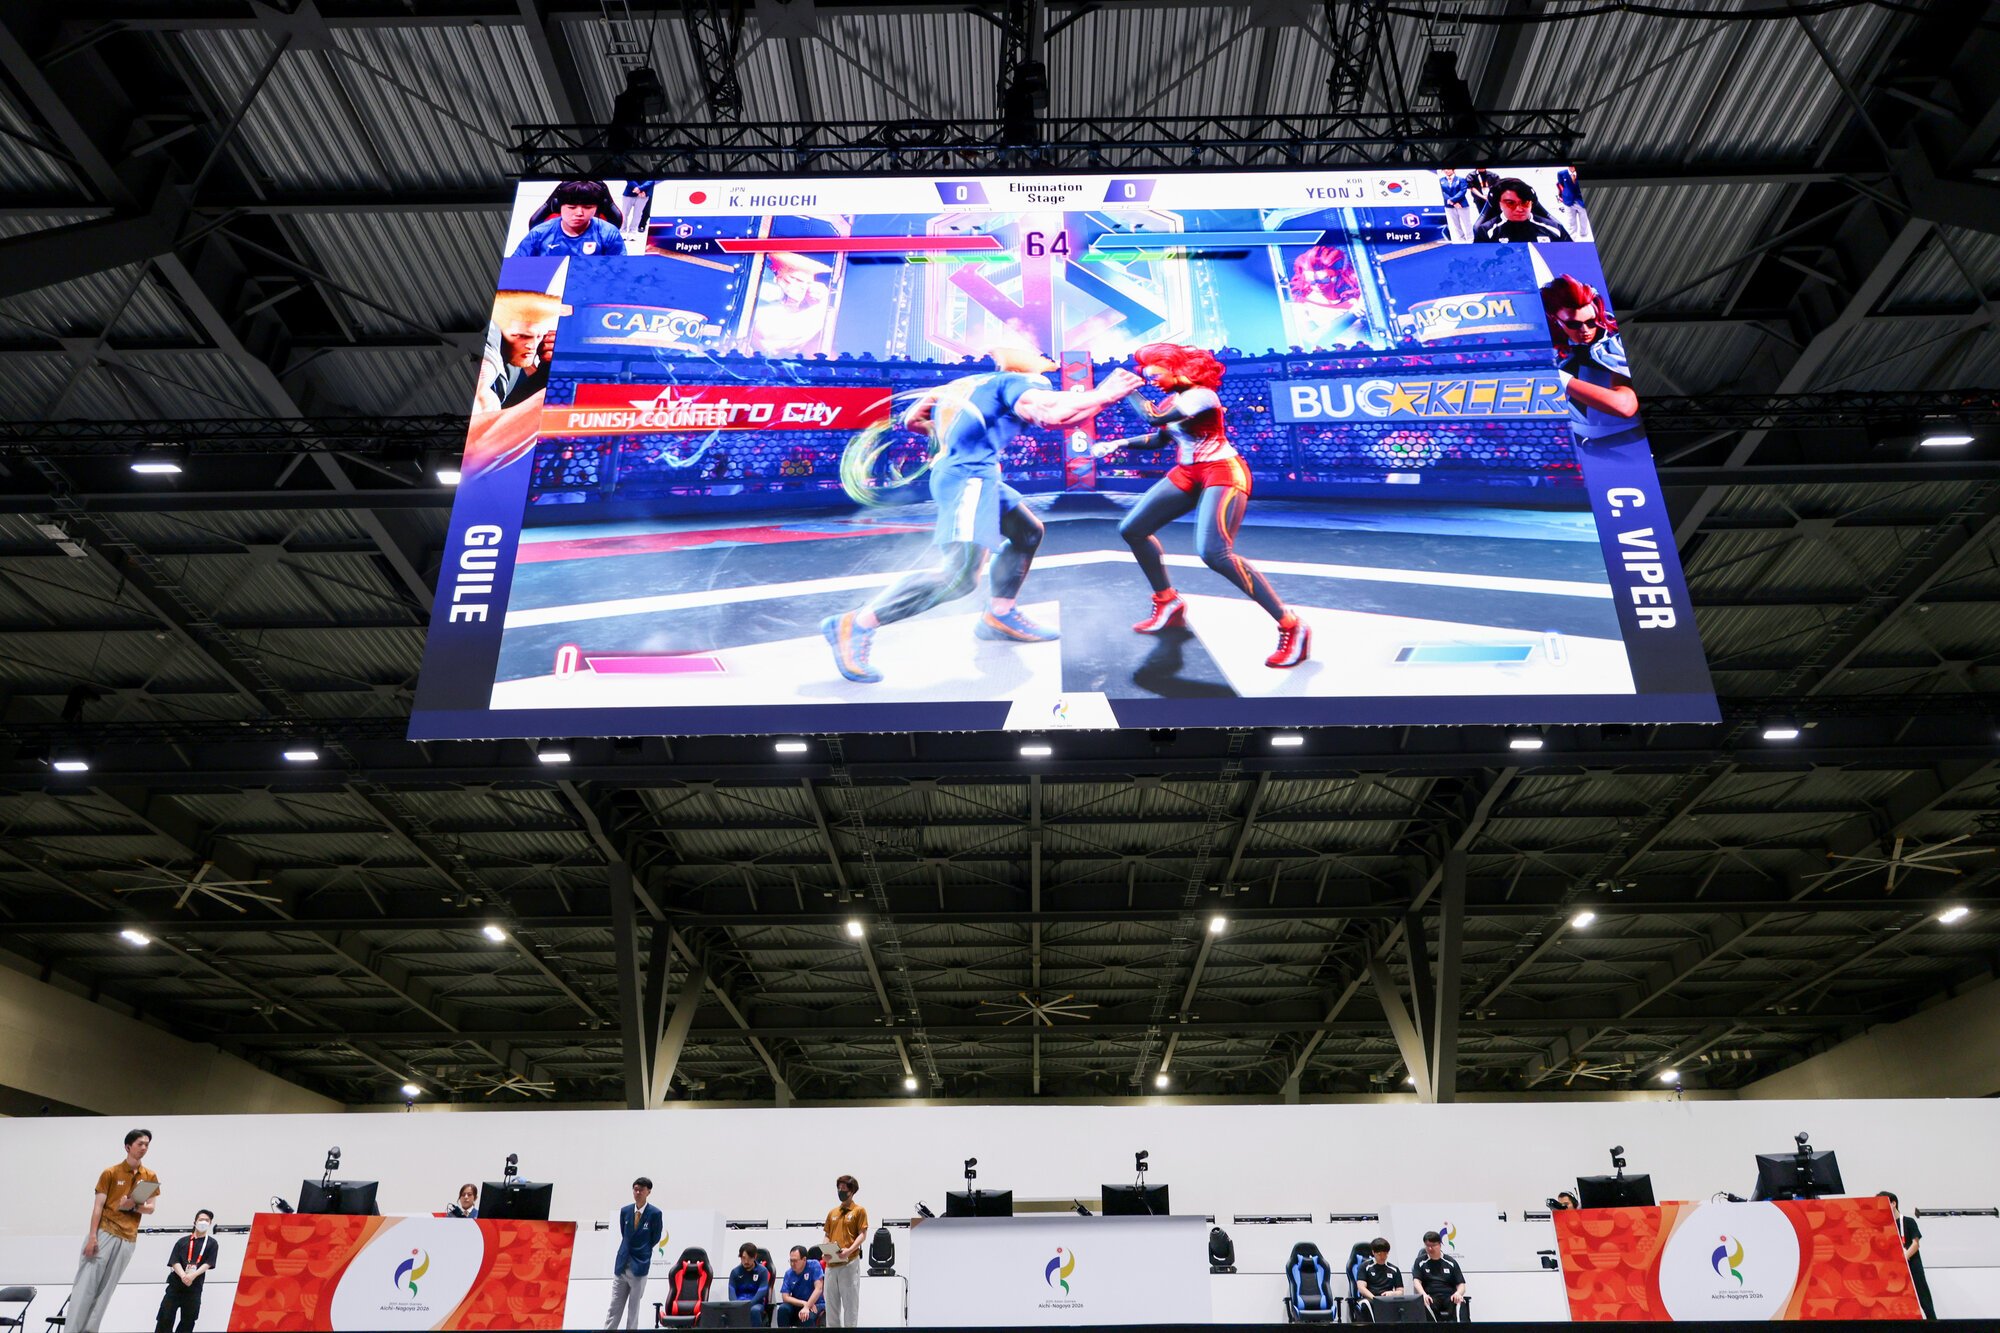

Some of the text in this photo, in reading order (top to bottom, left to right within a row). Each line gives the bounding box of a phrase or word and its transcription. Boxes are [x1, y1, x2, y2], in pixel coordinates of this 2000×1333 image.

[956, 185, 968, 201] 0
[1009, 182, 1083, 193] Elimination
[1124, 183, 1136, 198] 0
[1305, 187, 1364, 199] YEON J
[729, 194, 817, 207] K. HIGUCHI
[1027, 193, 1065, 204] Stage
[1026, 230, 1070, 257] 64
[1386, 232, 1421, 242] Player 2
[675, 242, 709, 252] Player 1
[1413, 299, 1516, 329] APCOM
[601, 311, 704, 339] CAPCO
[567, 410, 728, 429] PUNISH COUNTER
[781, 402, 842, 427] City
[1072, 431, 1088, 452] 6
[1606, 487, 1677, 629] C. VIPER
[449, 524, 503, 623] GUILE
[555, 645, 578, 679] 0
